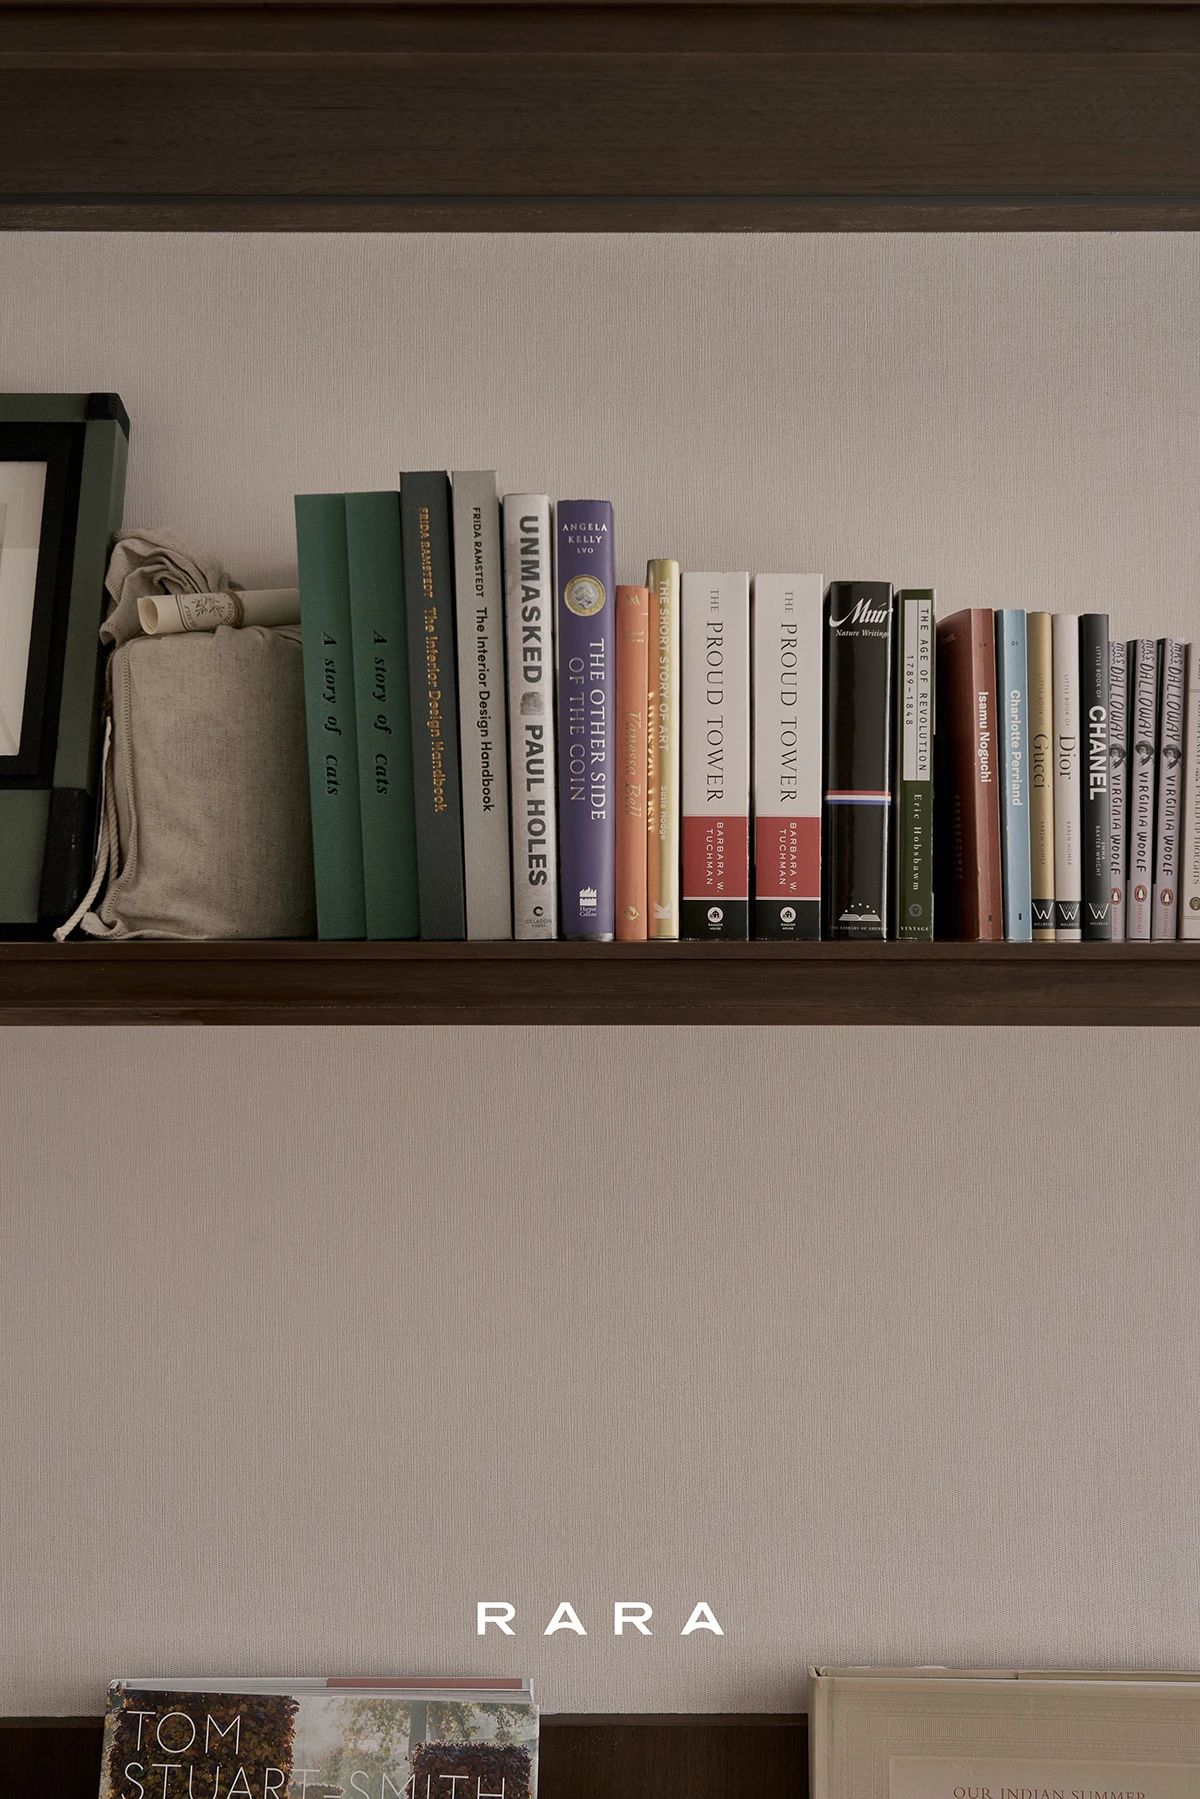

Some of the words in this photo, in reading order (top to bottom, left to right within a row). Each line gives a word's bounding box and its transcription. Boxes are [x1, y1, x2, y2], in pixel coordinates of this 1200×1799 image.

[420, 507, 430, 538] FRIDA
[472, 507, 482, 539] FRIDA
[562, 523, 608, 532] ANGELA
[568, 536, 602, 544] KELLY
[421, 542, 433, 598] RAMSTEDT
[474, 541, 484, 598] RAMSTEDT
[660, 580, 669, 602] THE
[424, 607, 438, 632] The
[476, 607, 488, 632] The
[519, 516, 542, 683] UNMASKED
[710, 590, 719, 613] THE
[785, 592, 793, 613] THE
[921, 608, 929, 630] THE
[323, 632, 337, 645] A
[373, 630, 388, 644] A
[660, 608, 669, 650] SHORT
[920, 640, 928, 660] AGE
[323, 658, 338, 704] story
[372, 657, 386, 702] story
[426, 636, 440, 687] Interior
[477, 636, 490, 688] Interior
[568, 657, 584, 685] OF
[590, 638, 605, 680] THE
[660, 656, 669, 698] STORY
[706, 622, 724, 705] PROUD
[780, 624, 797, 706] PROUD
[920, 670, 928, 683] OF
[427, 690, 442, 738] Design
[477, 690, 491, 738] Design
[570, 692, 585, 736] THE
[660, 704, 668, 720] OF
[978, 692, 989, 728] Isamu
[1096, 690, 1102, 698] OF
[1110, 666, 1124, 740] DALLOWAY
[1138, 662, 1154, 738] DALLOWAY
[1166, 666, 1182, 742] DALLOWAY
[324, 716, 342, 736] of
[374, 714, 391, 734] of
[590, 689, 606, 764] OTHER
[659, 725, 668, 750] ART
[919, 692, 928, 770] REVOLUTION
[1010, 690, 1022, 748] Charlotte
[525, 724, 545, 792] PAUL
[624, 712, 642, 776] Vanessa
[706, 716, 724, 802] TOWER
[780, 716, 798, 802] TOWER
[978, 732, 991, 782] Noguchi
[1033, 734, 1050, 788] Gucci
[1059, 734, 1076, 780] Dior
[1089, 706, 1106, 800] CHANEL
[432, 741, 448, 812] Handbook
[480, 741, 494, 812] Handbook
[570, 744, 586, 801] COIN
[1012, 752, 1023, 806] Perriand
[590, 772, 606, 820] SIDE
[624, 783, 642, 818] Bell
[914, 794, 922, 819] Eric
[1112, 774, 1122, 830] VIRGINIA
[1138, 772, 1150, 826] VIRGINIA
[1165, 775, 1176, 830] VIRGINIA
[527, 800, 548, 886] HOLES
[913, 826, 922, 890] Hobsbawm
[1110, 834, 1120, 874] WOOLF
[1136, 832, 1148, 872] WOOLF
[1163, 835, 1174, 876] WOOLF
[716, 884, 724, 892] W.
[790, 884, 797, 893] W.
[126, 1710, 242, 1755] TOM
[122, 1762, 506, 1799] STUART-SMITH
[953, 1786, 992, 1799] OUR
[1000, 1788, 1064, 1799] INDIAN
[1071, 1790, 1146, 1799] SUMMER
